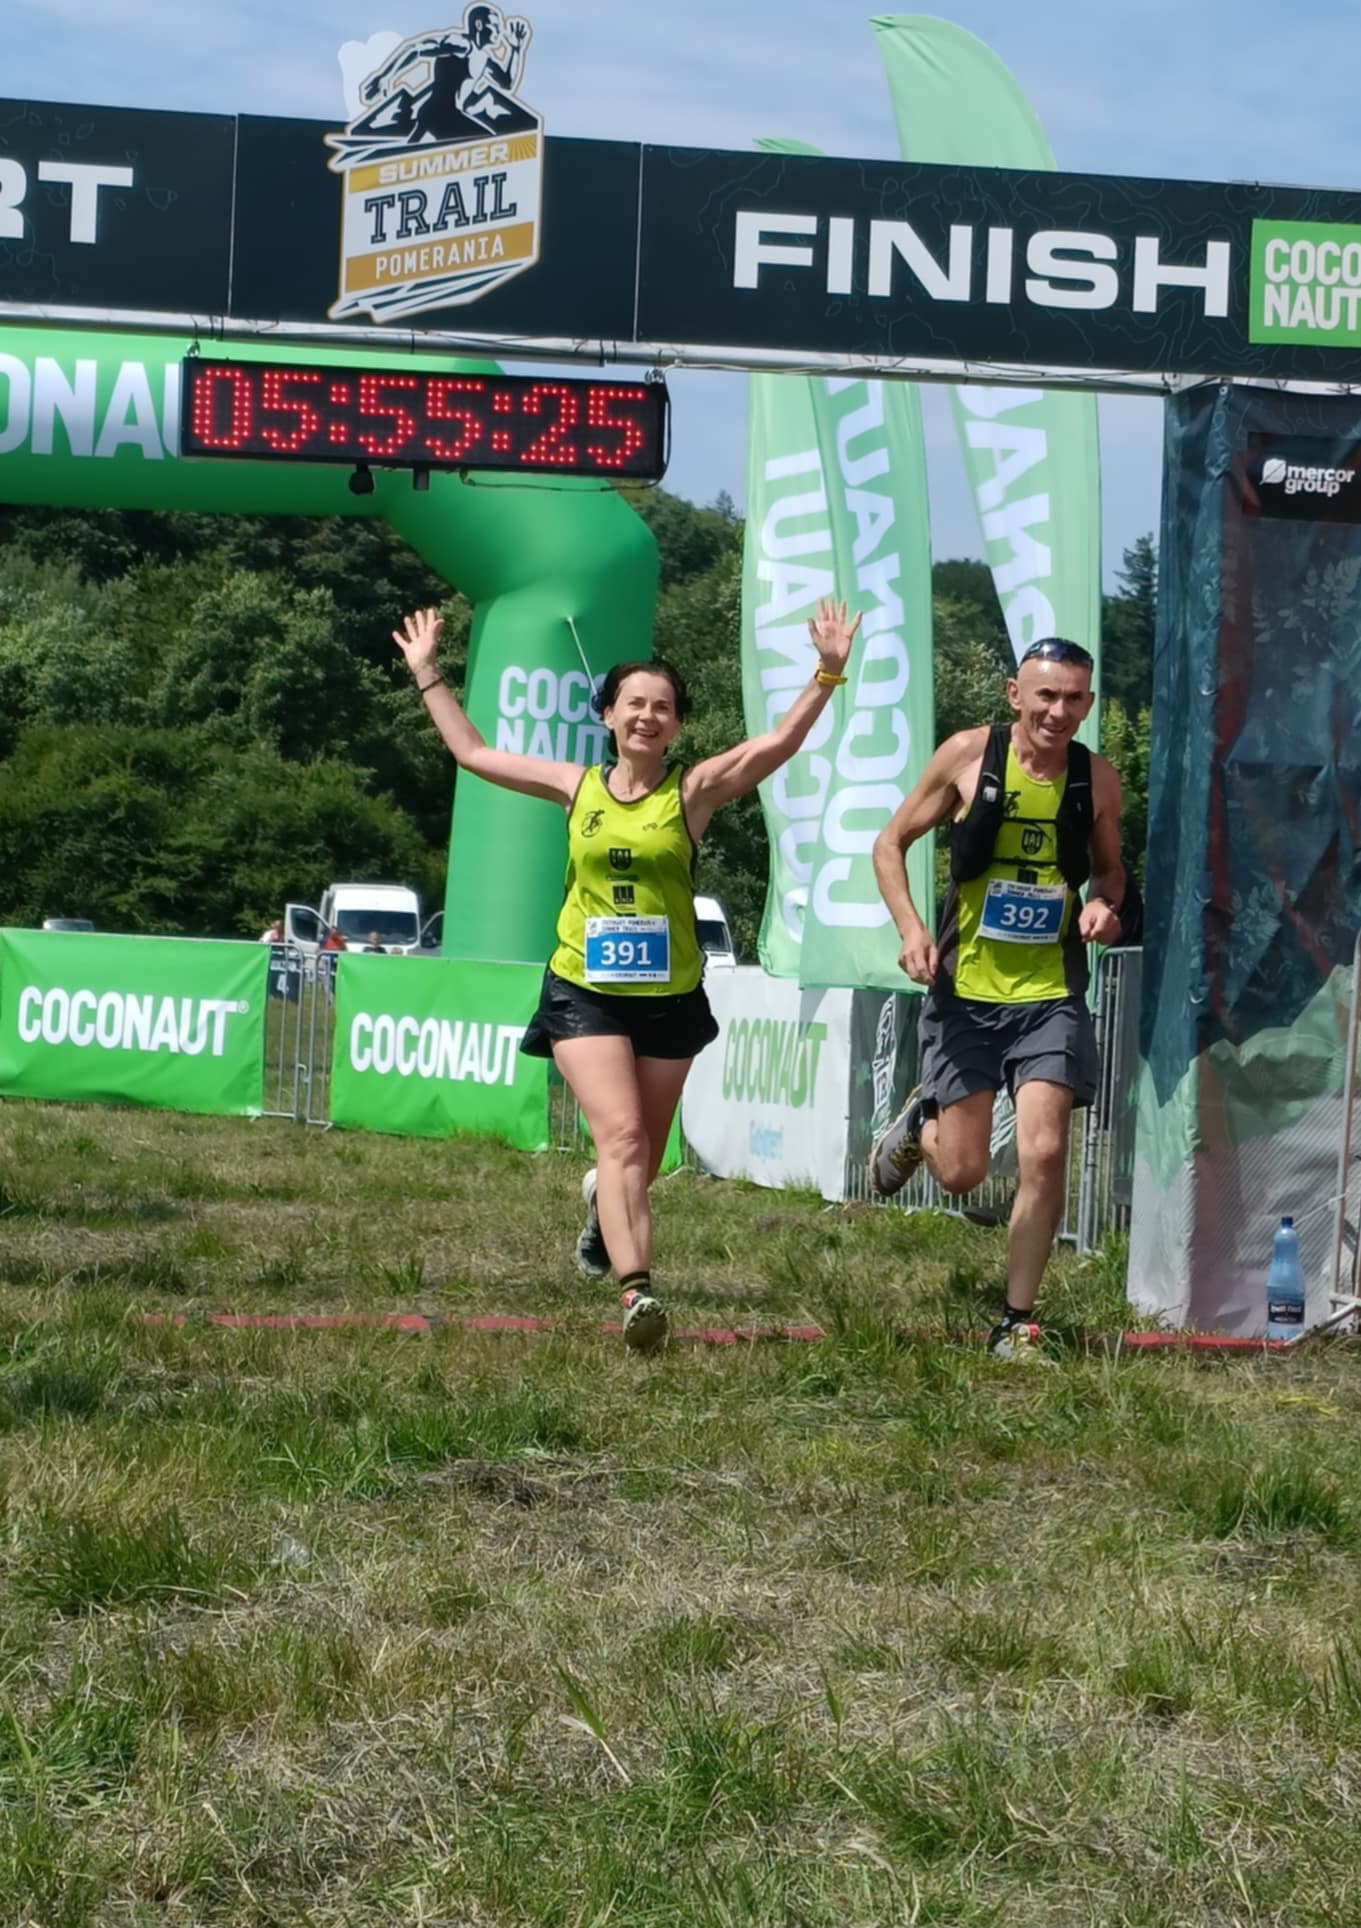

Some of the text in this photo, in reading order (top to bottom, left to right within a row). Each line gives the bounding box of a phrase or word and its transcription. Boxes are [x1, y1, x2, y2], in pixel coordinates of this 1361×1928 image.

[378, 143, 510, 186] SUMMER
[364, 173, 517, 245] TRAIL
[375, 235, 505, 280] POMERANIA
[734, 211, 1230, 317] FINISH
[1265, 238, 1361, 287] COCO
[1263, 283, 1361, 331] NAUT
[194, 368, 647, 466] 05:55:25
[1284, 478, 1340, 497] group
[1287, 465, 1355, 482] mercor
[1001, 903, 1049, 929] 392
[600, 941, 652, 966] 391
[351, 1012, 528, 1086] COCONAUT
[722, 1018, 828, 1108] COCONAUT
